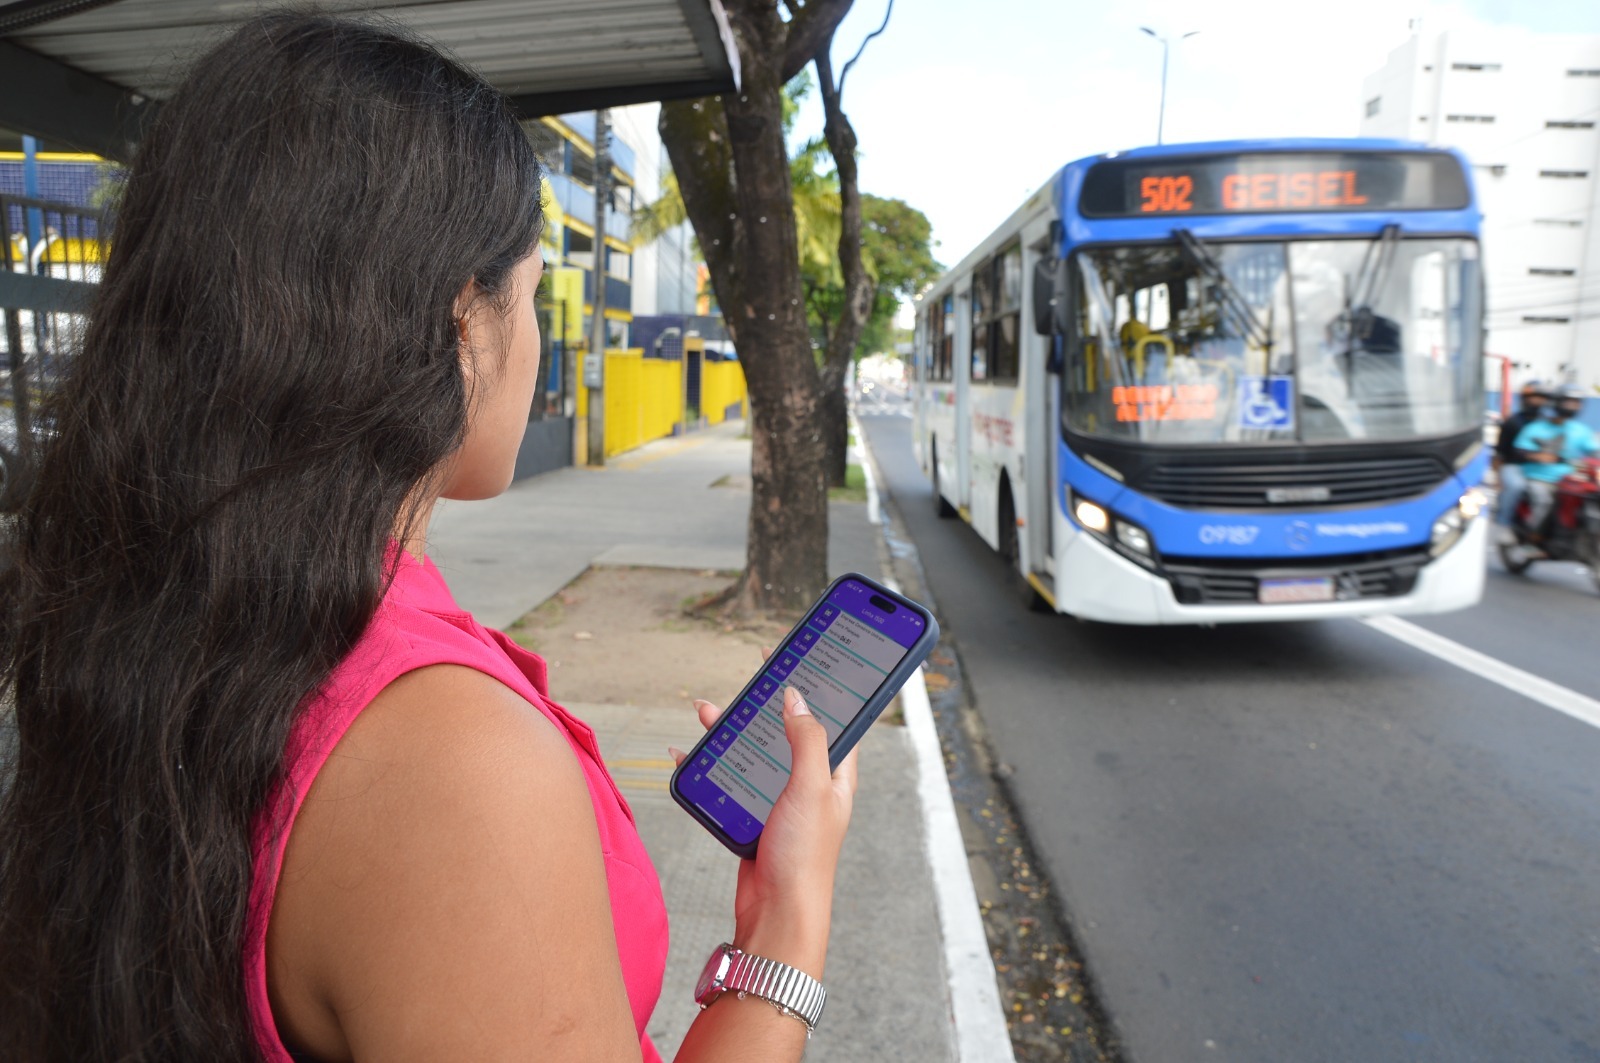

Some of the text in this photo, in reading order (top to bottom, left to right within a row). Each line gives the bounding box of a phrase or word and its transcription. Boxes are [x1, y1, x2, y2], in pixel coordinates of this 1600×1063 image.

[1140, 170, 1368, 212] 502 GEISEL
[860, 608, 874, 618] Linha
[755, 736, 768, 747] 07:37
[734, 762, 747, 773] 07:49
